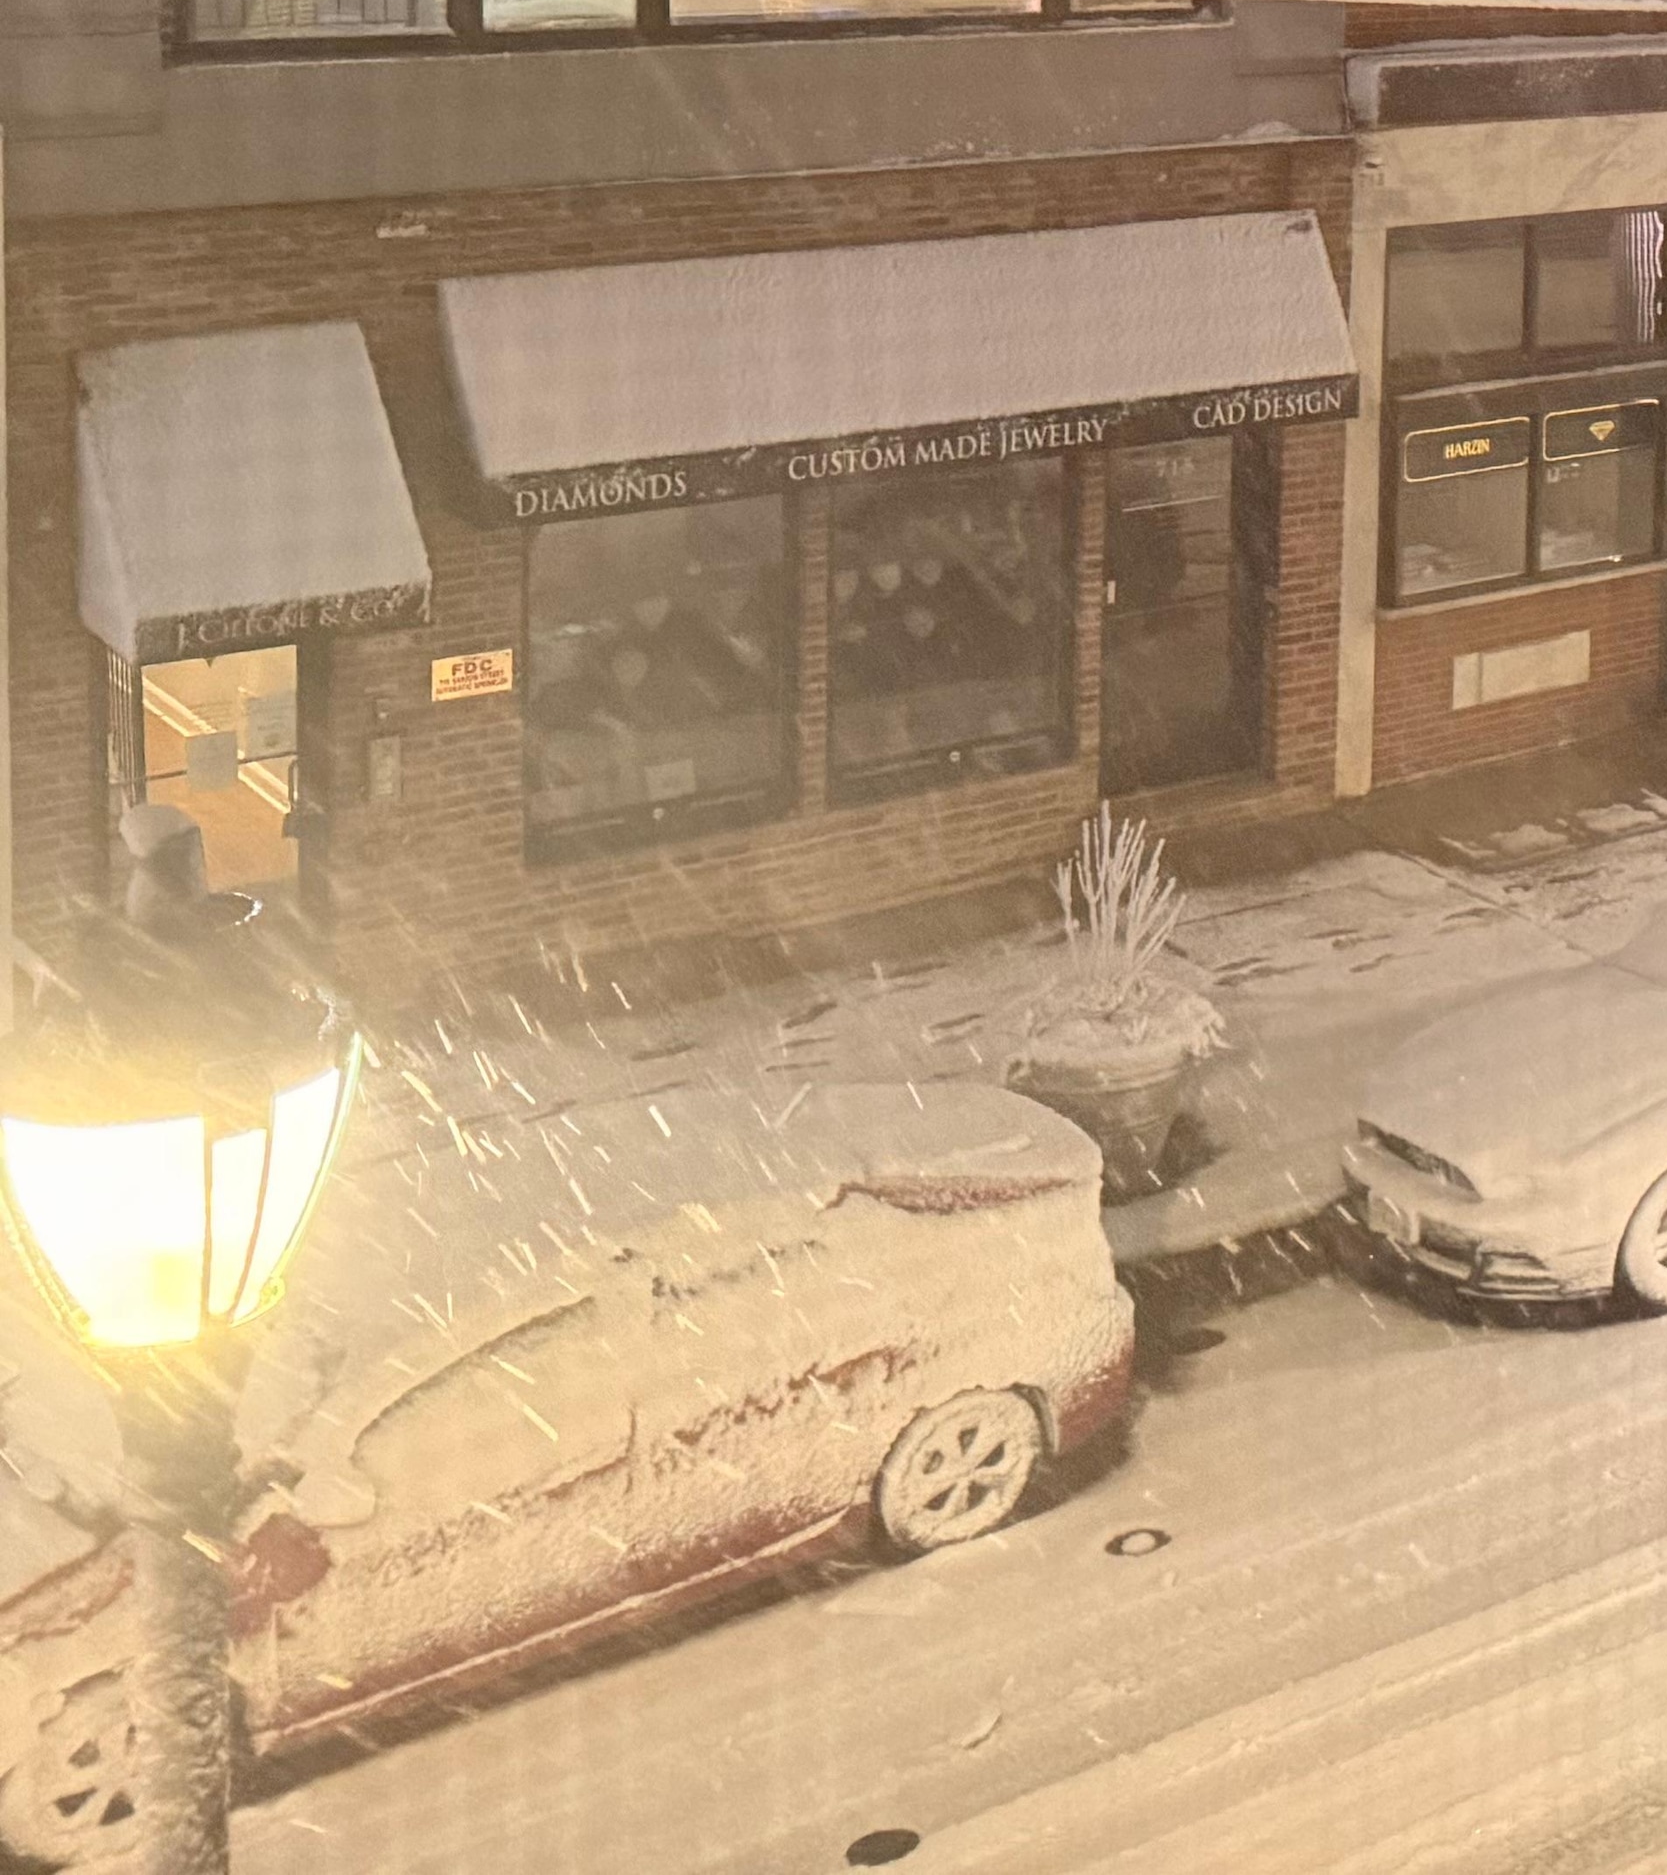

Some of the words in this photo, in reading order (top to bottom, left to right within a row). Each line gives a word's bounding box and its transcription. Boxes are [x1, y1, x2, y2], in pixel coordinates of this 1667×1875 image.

[1192, 402, 1247, 430] CAD
[1253, 389, 1342, 422] DESIGN
[788, 446, 905, 481] CUSTOM
[915, 432, 991, 465] MADE
[1000, 418, 1107, 460] JEWELRY
[1444, 438, 1490, 460] HARZIN
[515, 472, 687, 517] DIAMONDS
[451, 659, 493, 676] FDC
